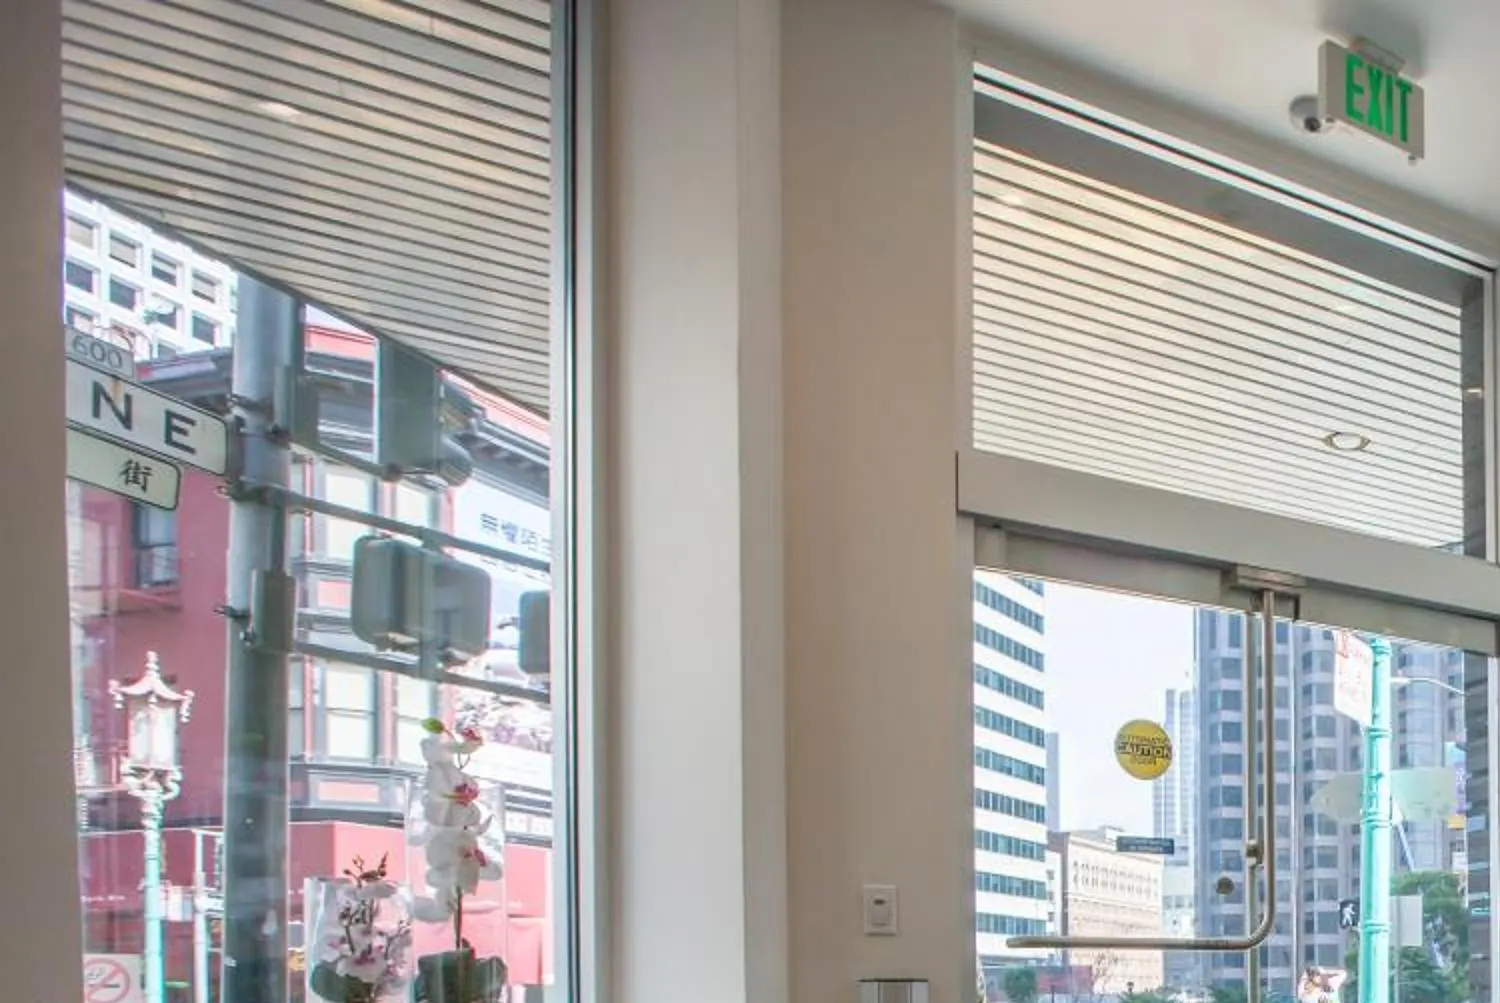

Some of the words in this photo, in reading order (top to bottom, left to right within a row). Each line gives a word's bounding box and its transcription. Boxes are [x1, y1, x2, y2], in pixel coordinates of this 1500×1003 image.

[1345, 53, 1412, 143] EXIT
[72, 335, 122, 368] 600
[120, 459, 152, 492] 街
